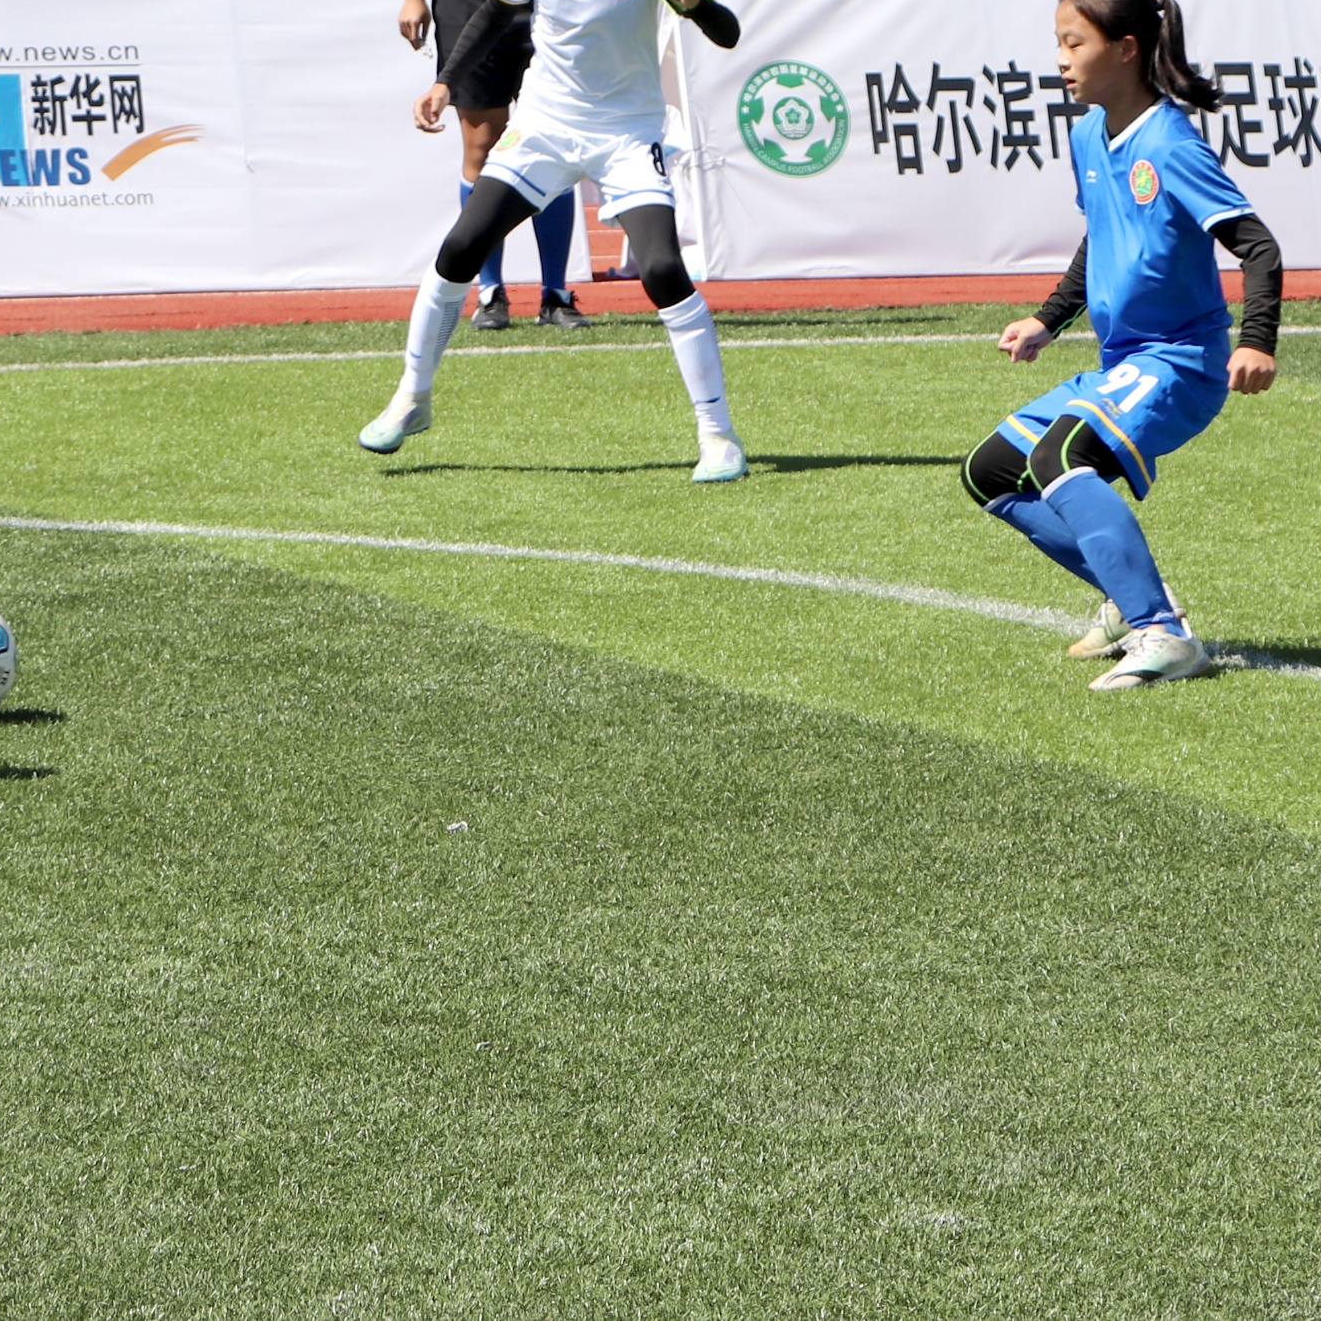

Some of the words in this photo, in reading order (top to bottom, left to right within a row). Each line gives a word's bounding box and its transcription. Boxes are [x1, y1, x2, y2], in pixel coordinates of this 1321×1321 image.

[30, 74, 145, 136] 新华网
[1096, 363, 1159, 413] 91
